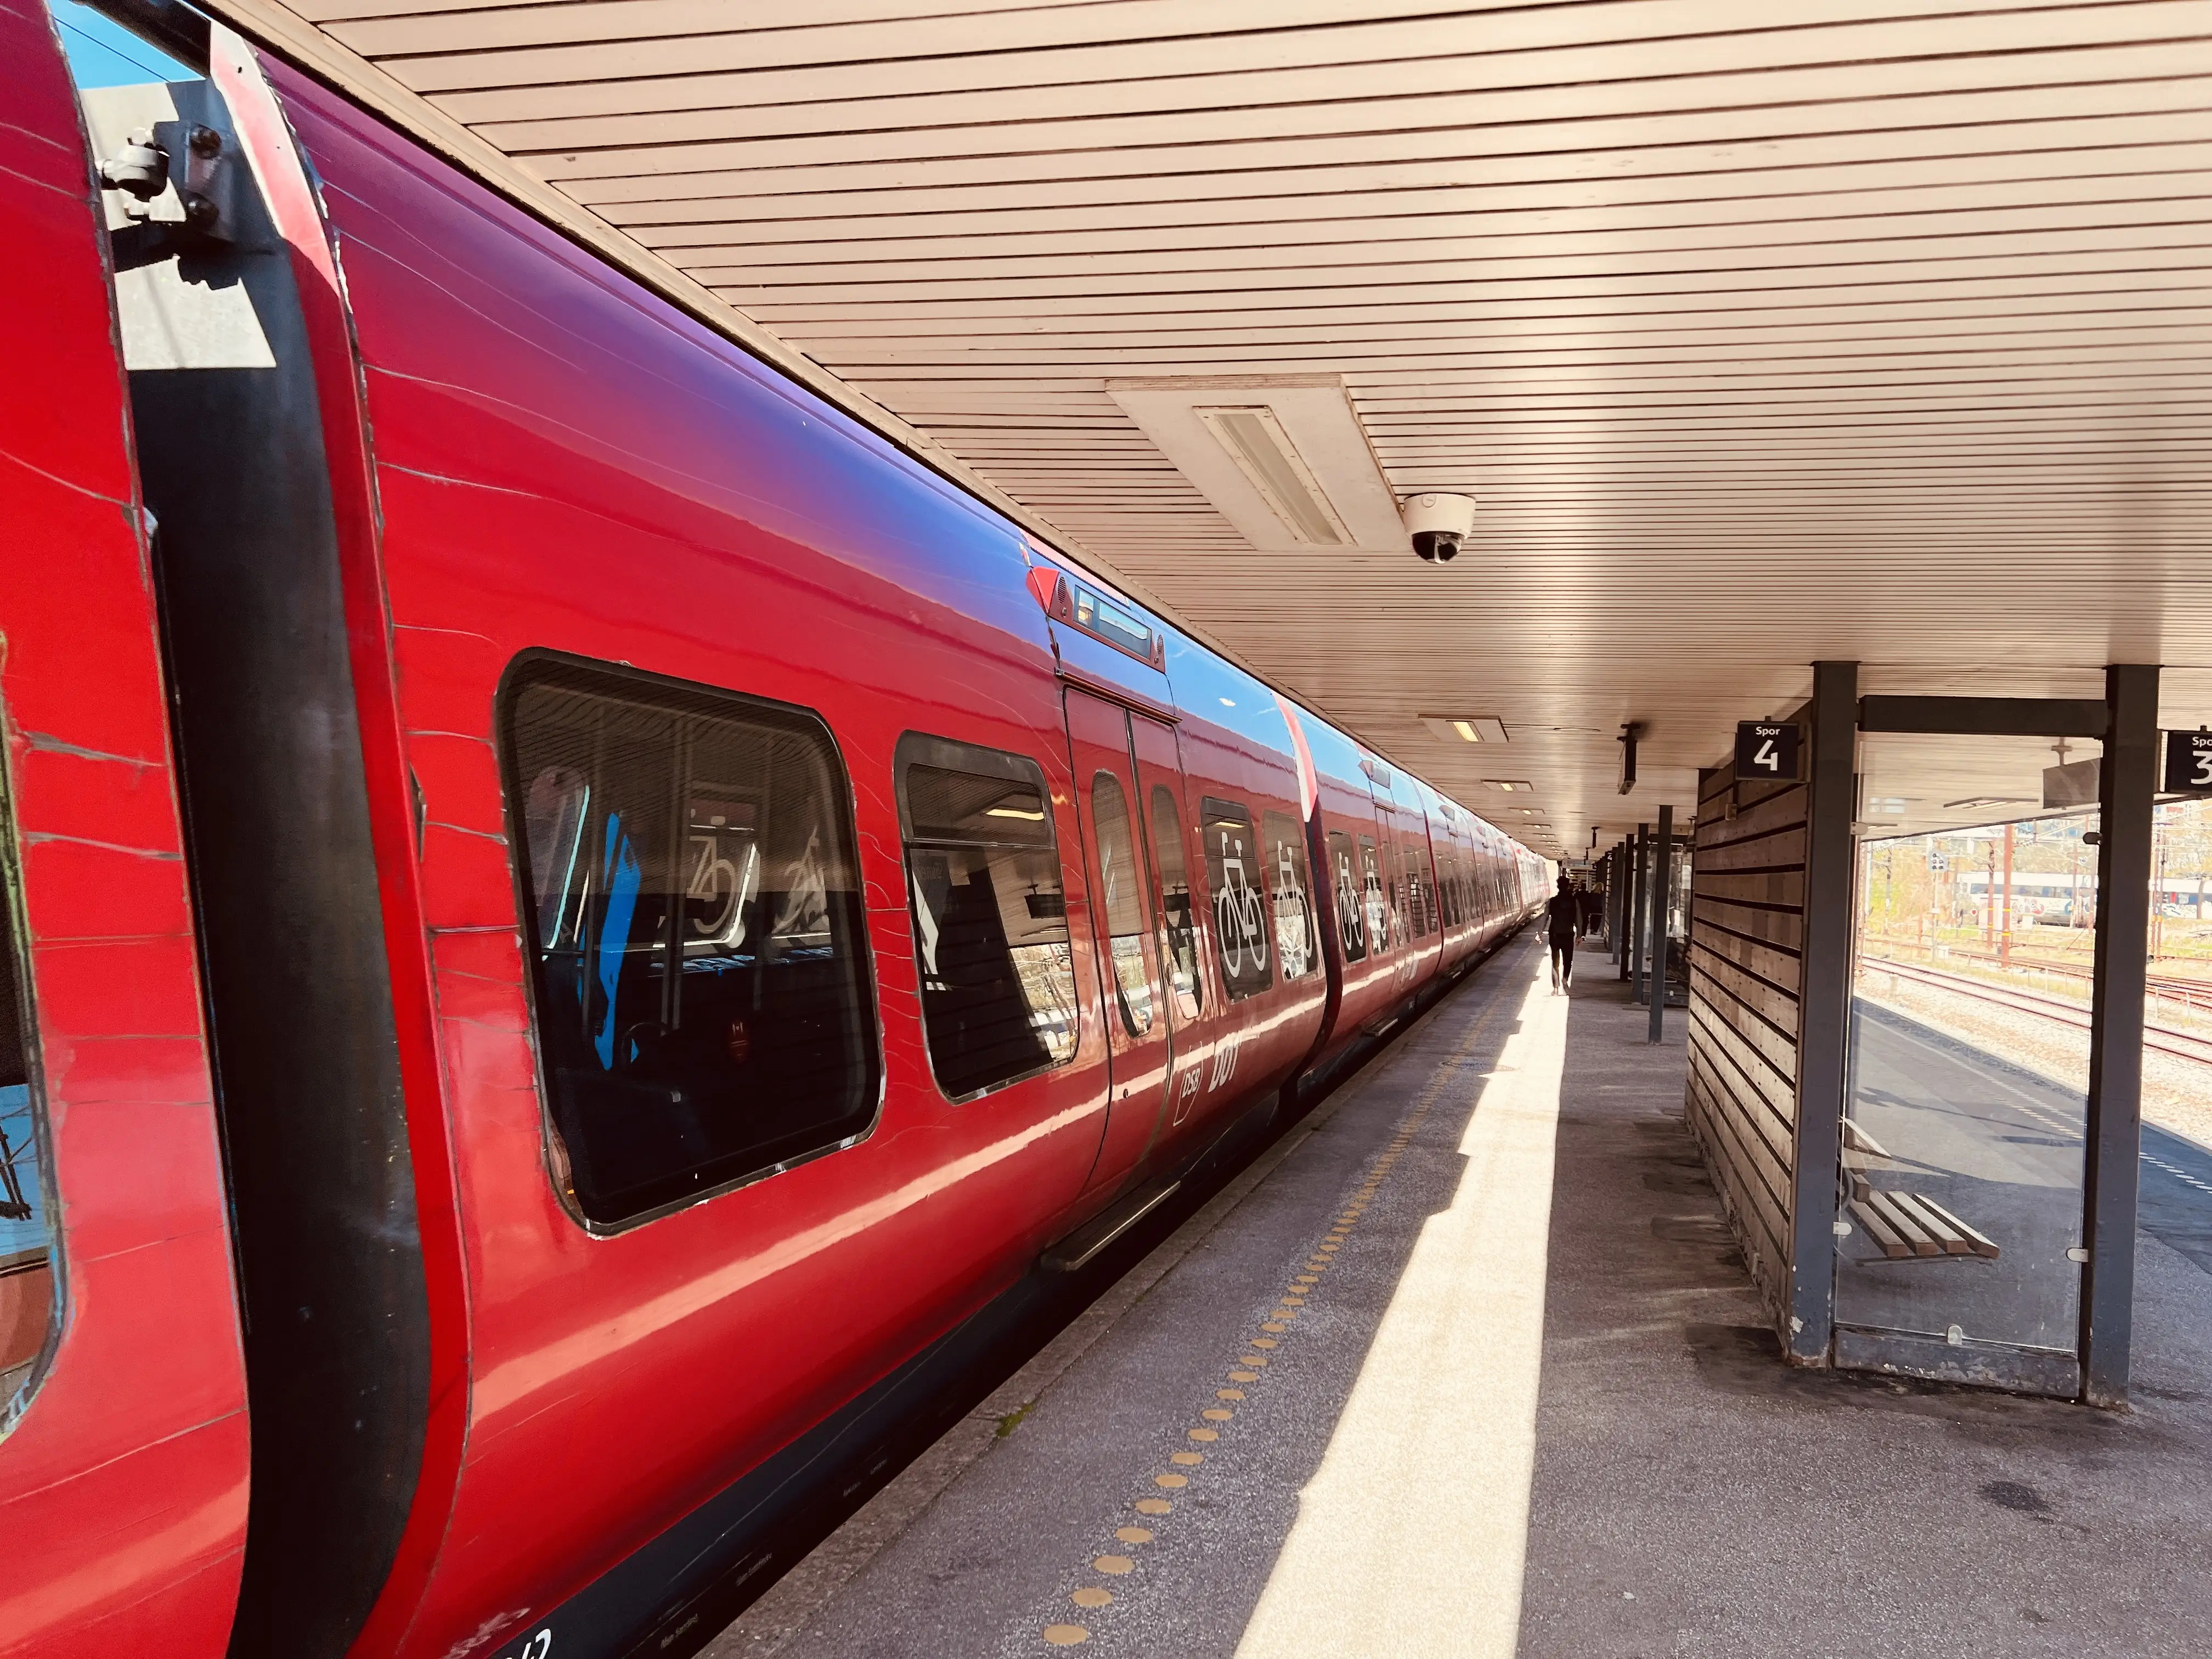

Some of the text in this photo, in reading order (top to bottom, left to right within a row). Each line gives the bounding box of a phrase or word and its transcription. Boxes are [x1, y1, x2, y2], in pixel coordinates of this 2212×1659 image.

[1756, 726, 1781, 737] Spor
[2192, 736, 2212, 748] Spo
[1753, 739, 1778, 771] 4
[2191, 751, 2212, 785] 3
[1181, 1068, 1201, 1098] DSB
